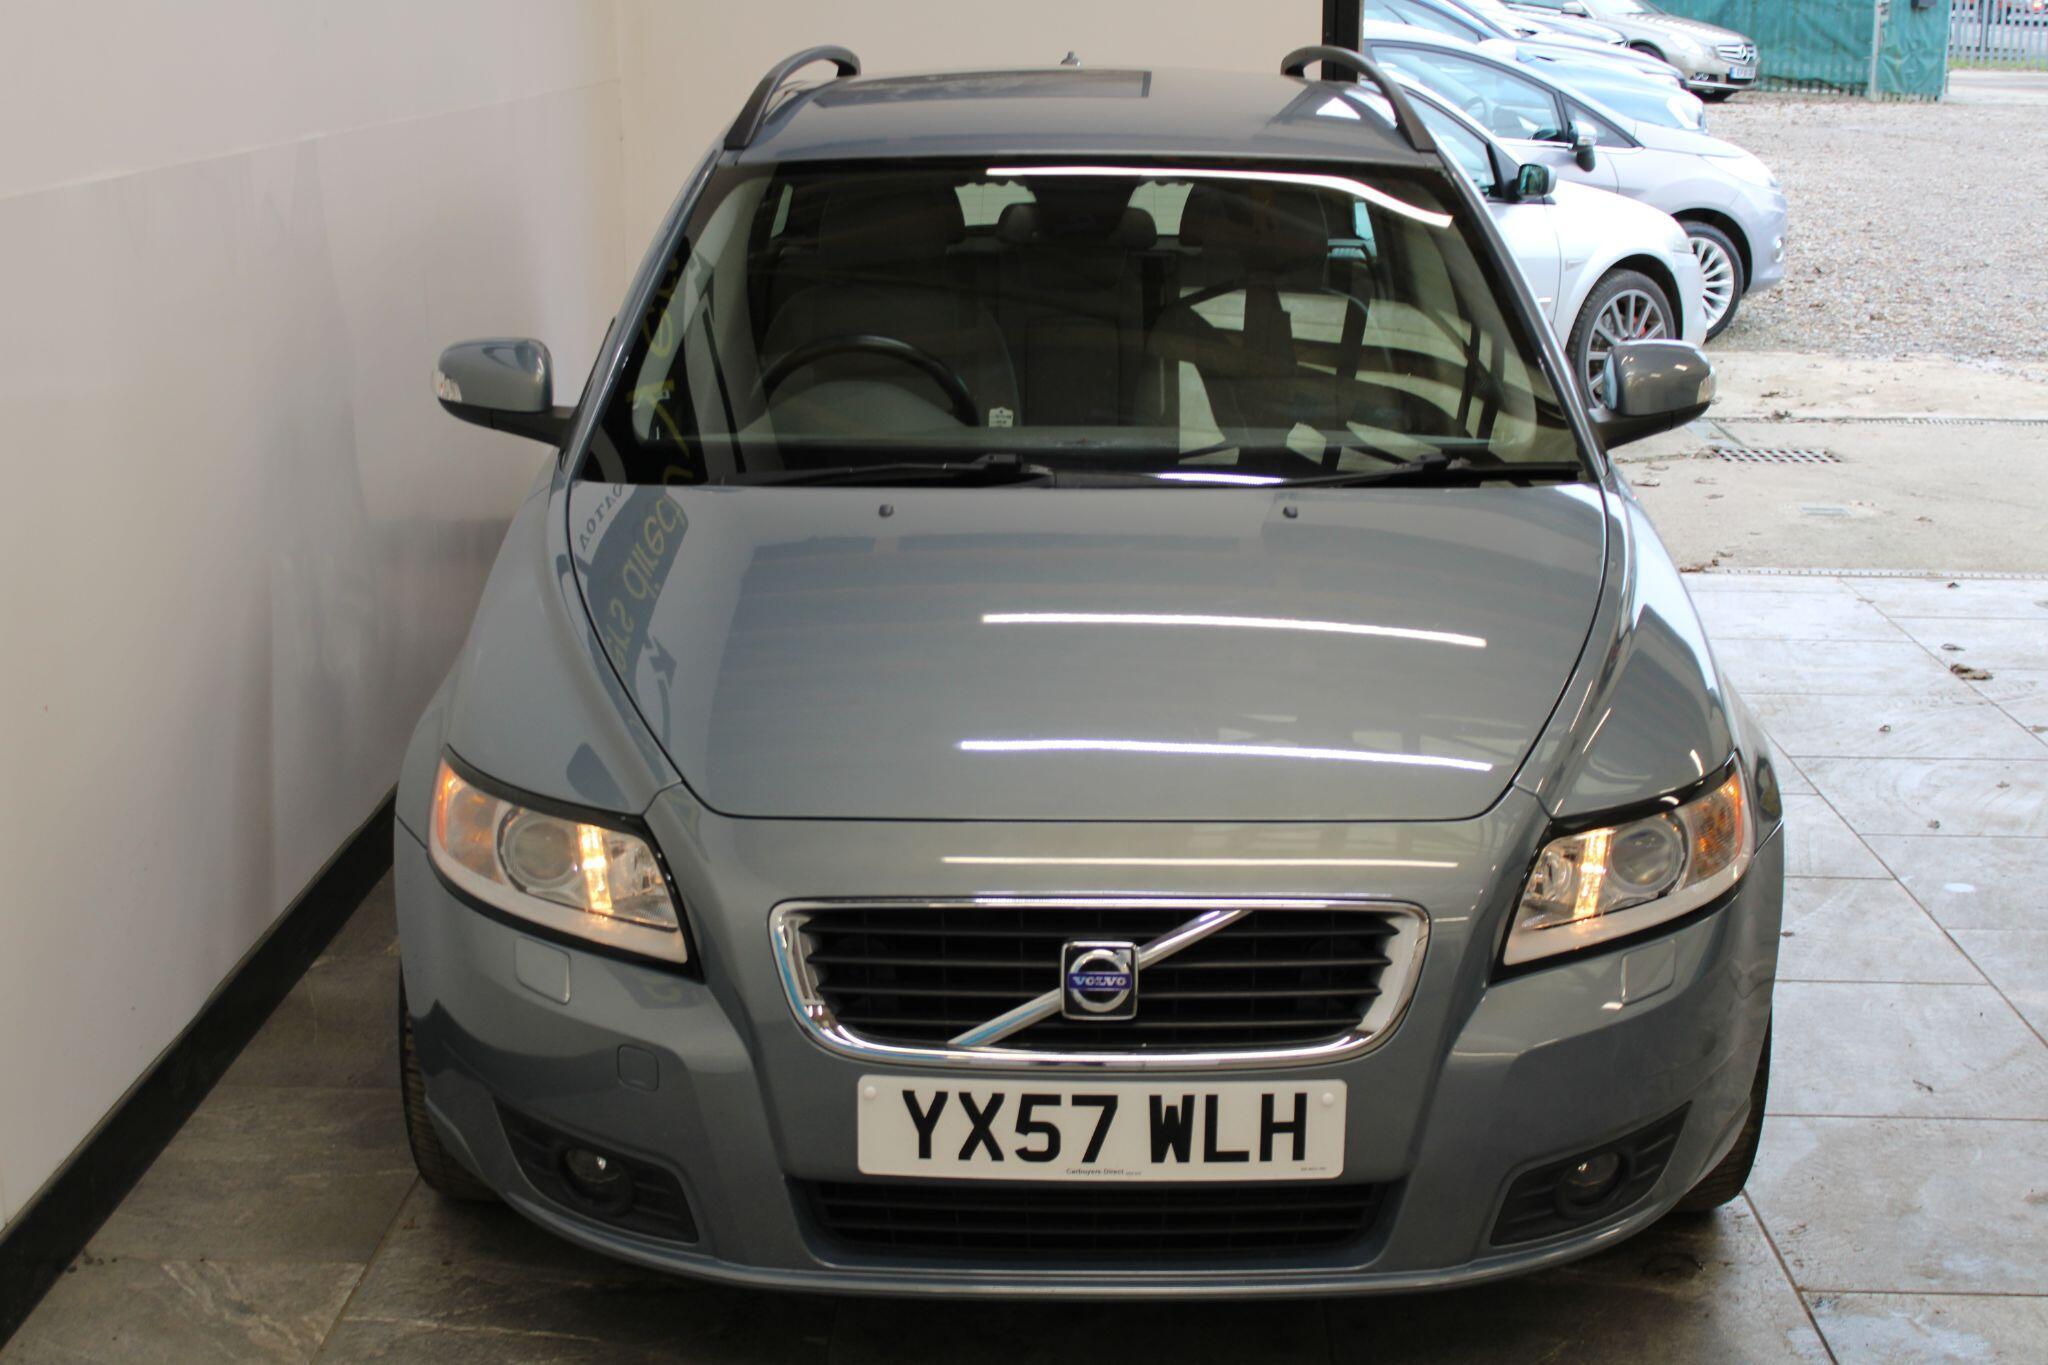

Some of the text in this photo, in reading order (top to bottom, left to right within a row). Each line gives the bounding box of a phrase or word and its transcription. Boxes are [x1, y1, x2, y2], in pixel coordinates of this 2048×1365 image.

[1072, 975, 1127, 987] VOLVO
[901, 1089, 1308, 1164] YX57 WLH
